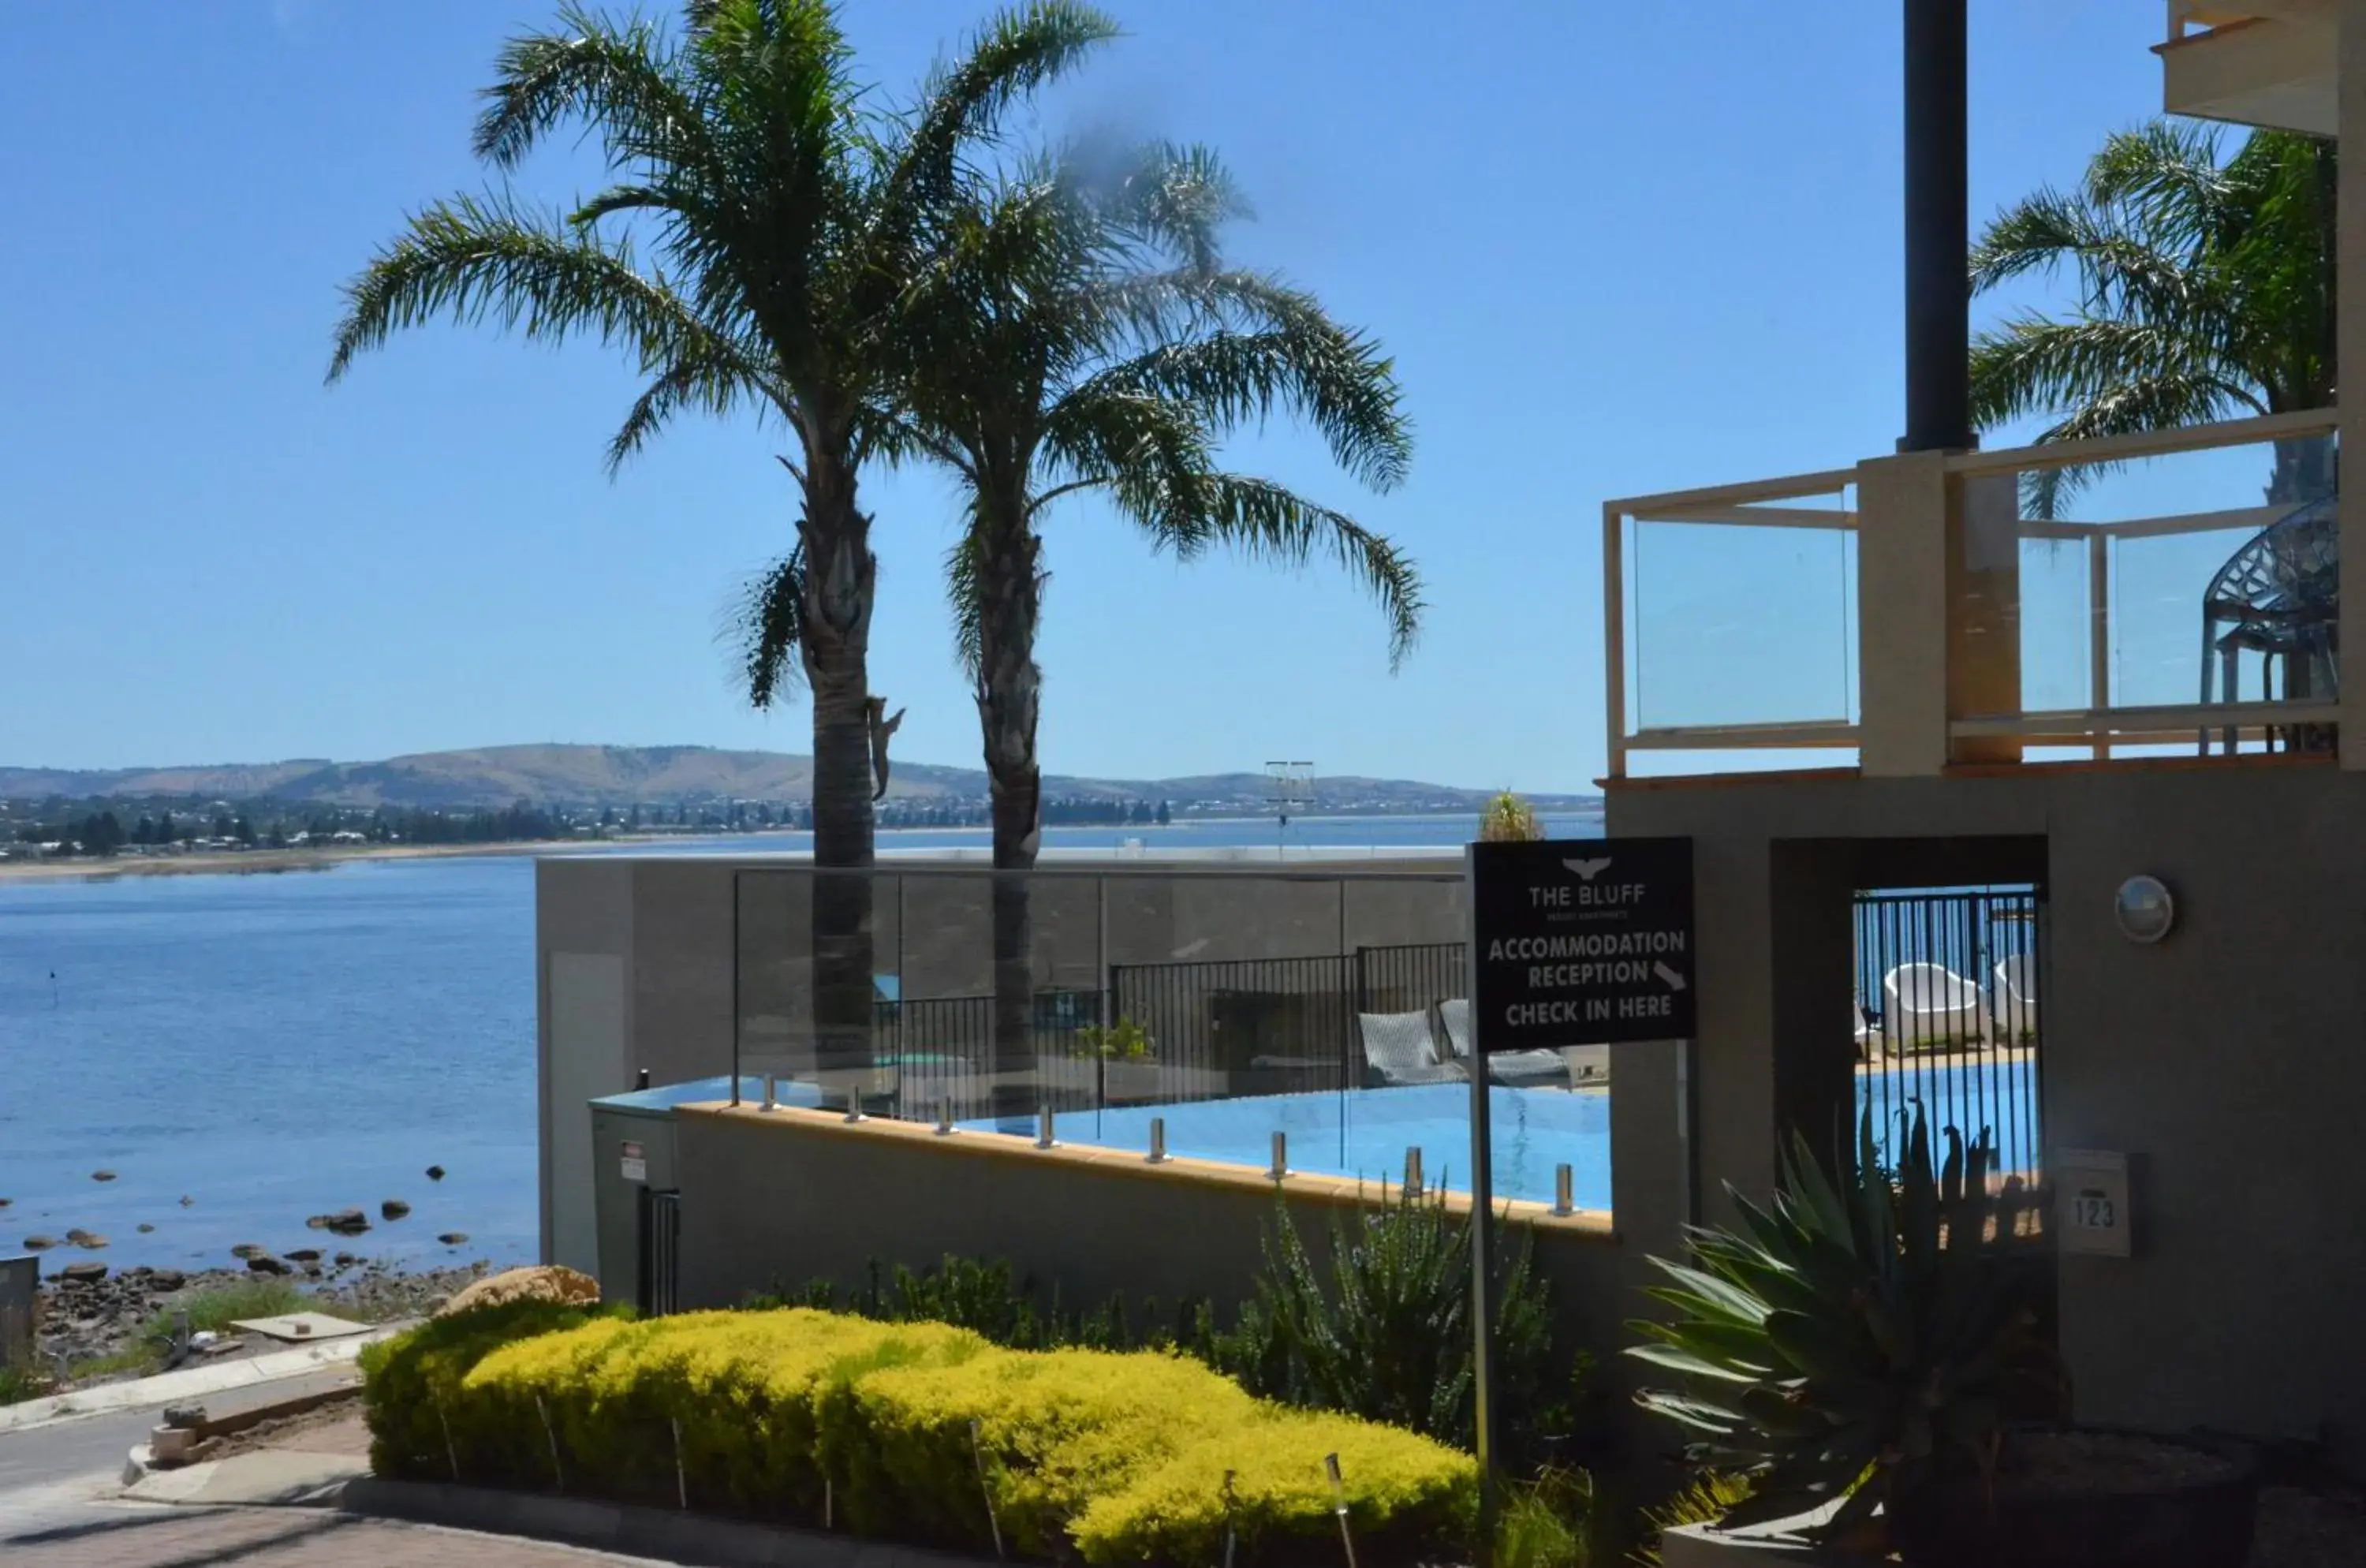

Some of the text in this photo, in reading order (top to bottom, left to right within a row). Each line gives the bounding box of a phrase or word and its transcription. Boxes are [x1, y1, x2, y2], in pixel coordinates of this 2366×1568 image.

[1528, 883, 1646, 907] THE BLUFF
[1488, 930, 1685, 961] ACCOMMODATION
[1528, 960, 1648, 987] RECEPTION
[1506, 995, 1672, 1026] CHECK IN HERE
[2076, 1199, 2114, 1228] 123
